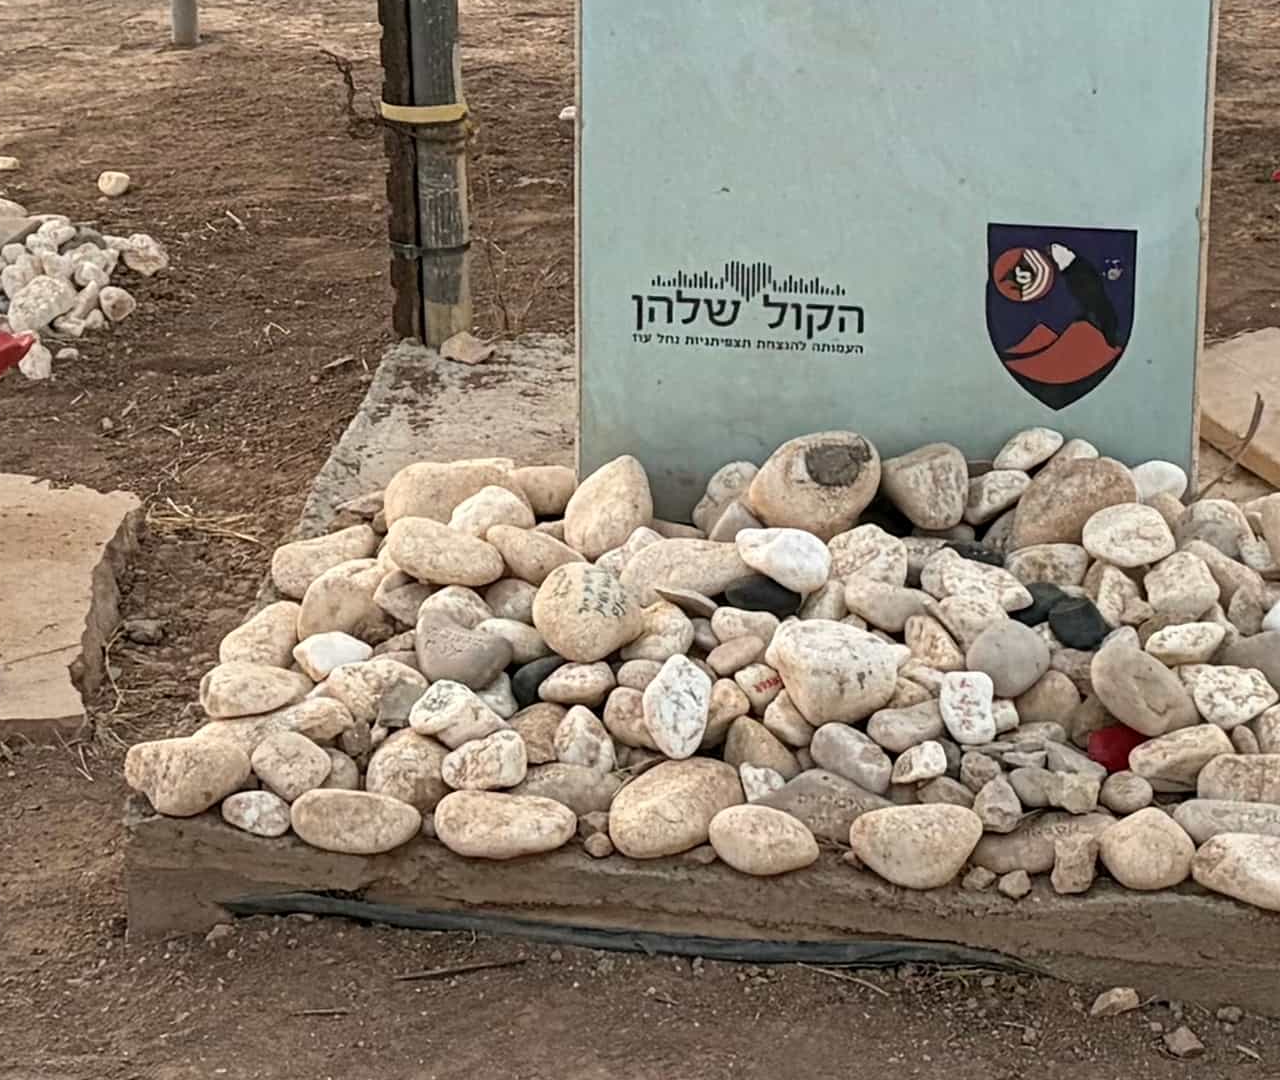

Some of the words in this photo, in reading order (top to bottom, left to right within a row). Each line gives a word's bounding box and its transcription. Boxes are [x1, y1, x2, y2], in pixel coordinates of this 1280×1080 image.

[631, 289, 742, 331] שלהן
[762, 293, 865, 340] הקול
[631, 332, 653, 344] עוז
[656, 331, 681, 345] נחל
[684, 335, 752, 349] תצפיתניות
[756, 339, 808, 352] להנצחת
[811, 343, 865, 355] העמותה
